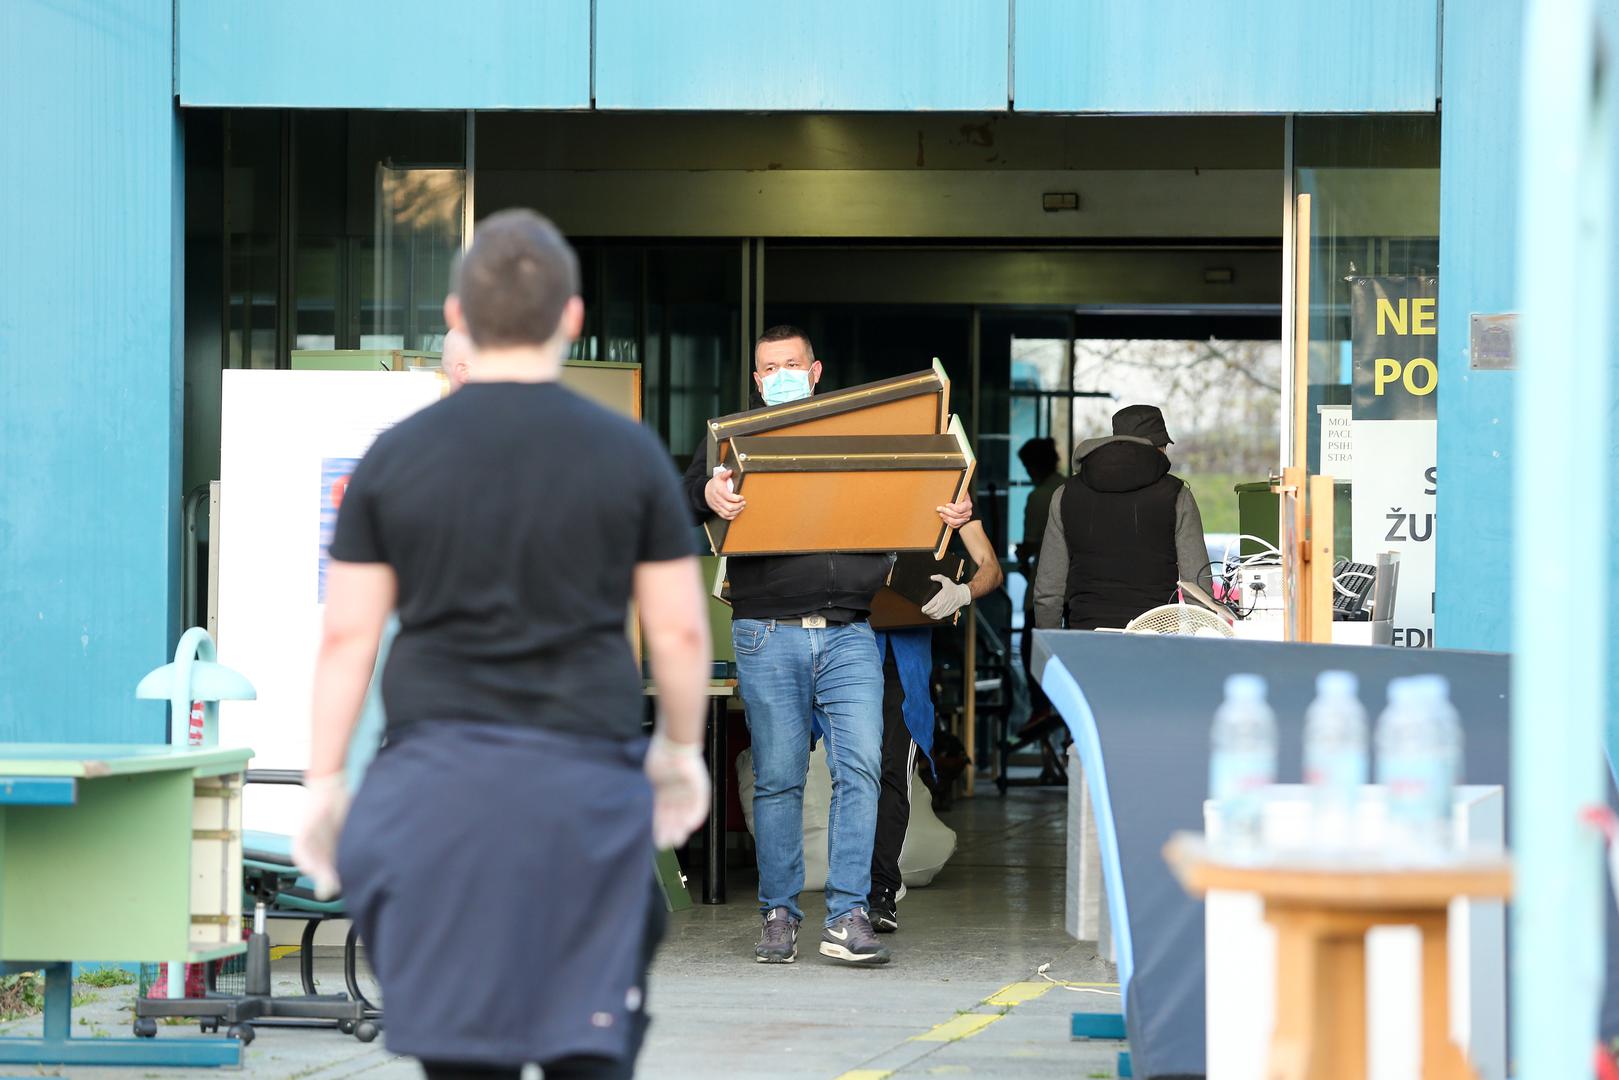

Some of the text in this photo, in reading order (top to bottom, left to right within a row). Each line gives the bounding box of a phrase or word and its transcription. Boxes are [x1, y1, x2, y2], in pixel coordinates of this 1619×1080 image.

[1376, 298, 1436, 335] NE
[1374, 358, 1438, 395] PO
[1384, 507, 1437, 542] ŽU
